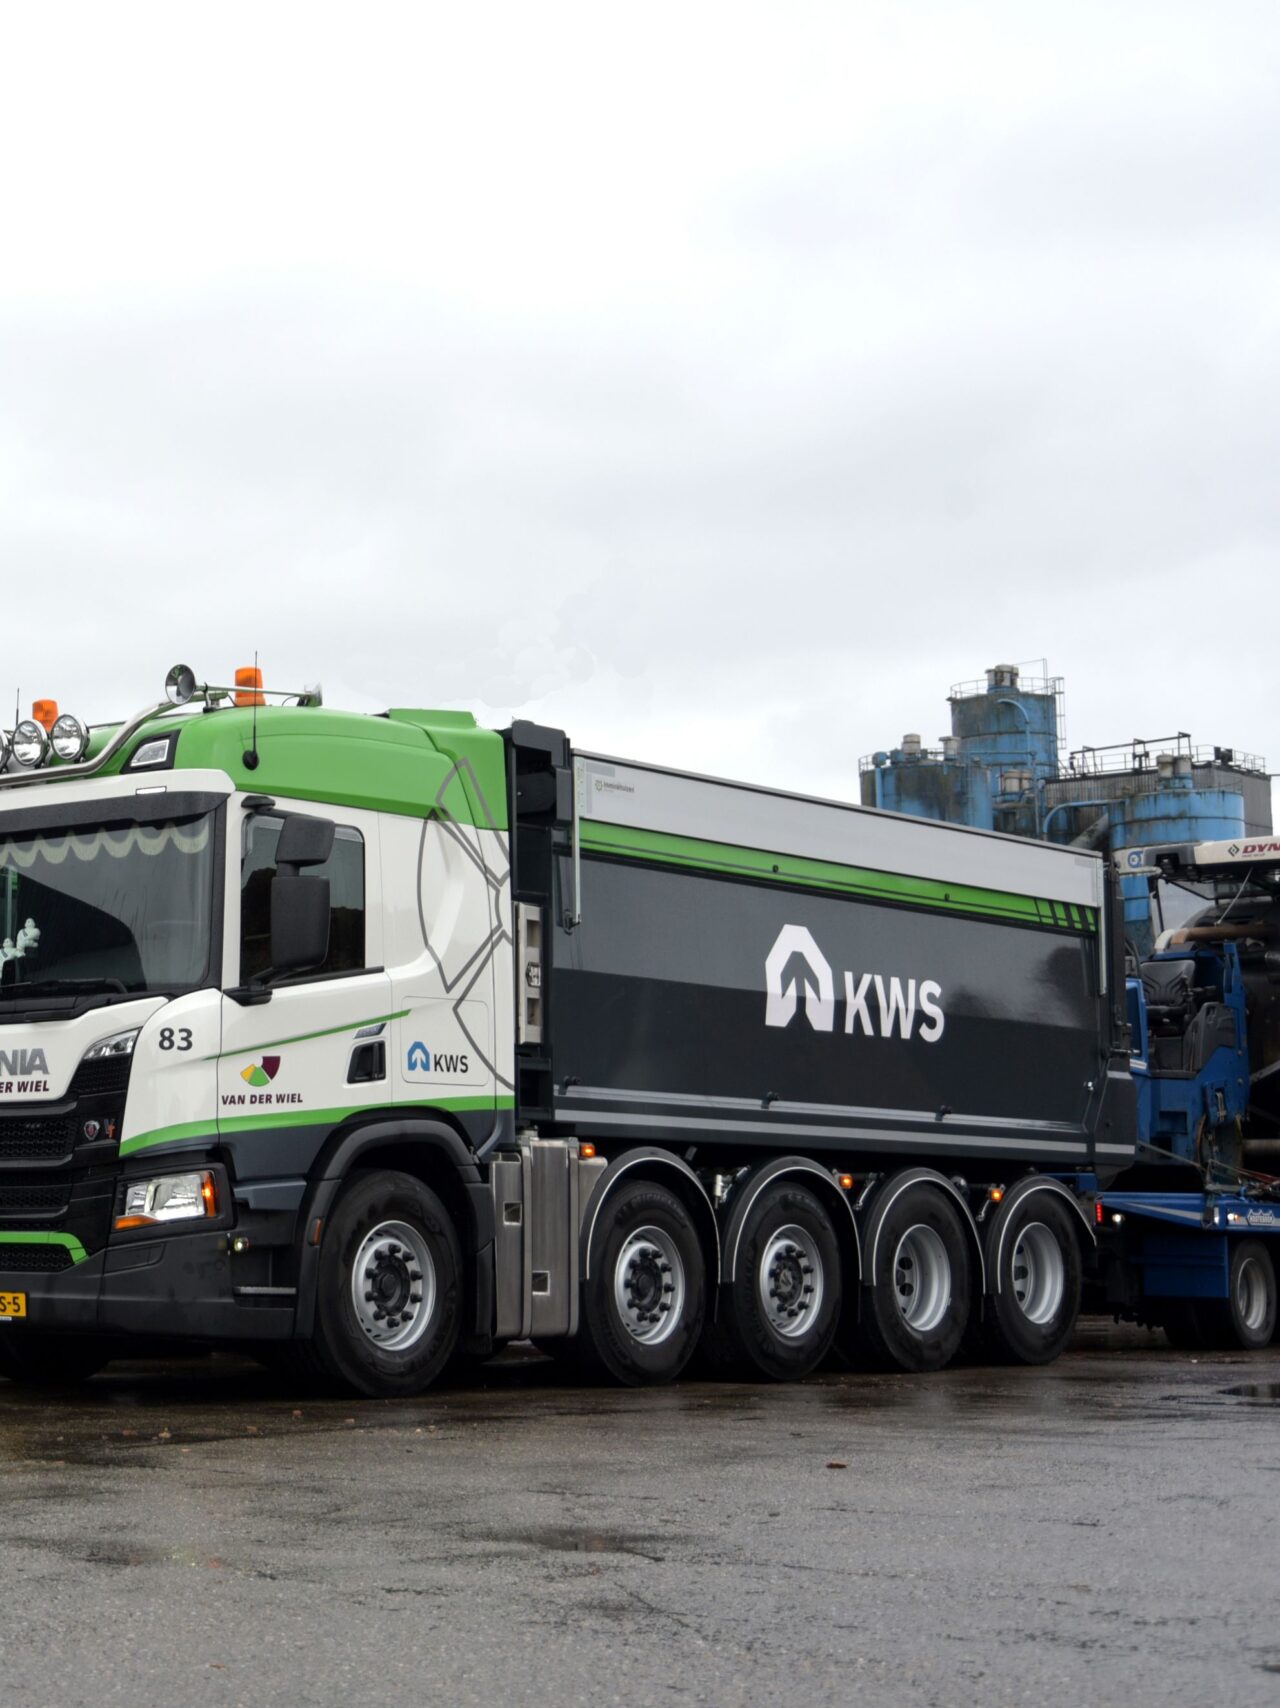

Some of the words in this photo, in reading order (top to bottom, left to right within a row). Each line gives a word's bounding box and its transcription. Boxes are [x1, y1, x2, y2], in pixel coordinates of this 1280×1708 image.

[844, 971, 945, 1042] KWS
[158, 1027, 193, 1051] 83
[433, 1053, 469, 1073] KWS
[17, 1080, 50, 1093] WIEL
[221, 1095, 246, 1105] VAN
[249, 1094, 273, 1104] DER
[275, 1093, 303, 1103] WIEL
